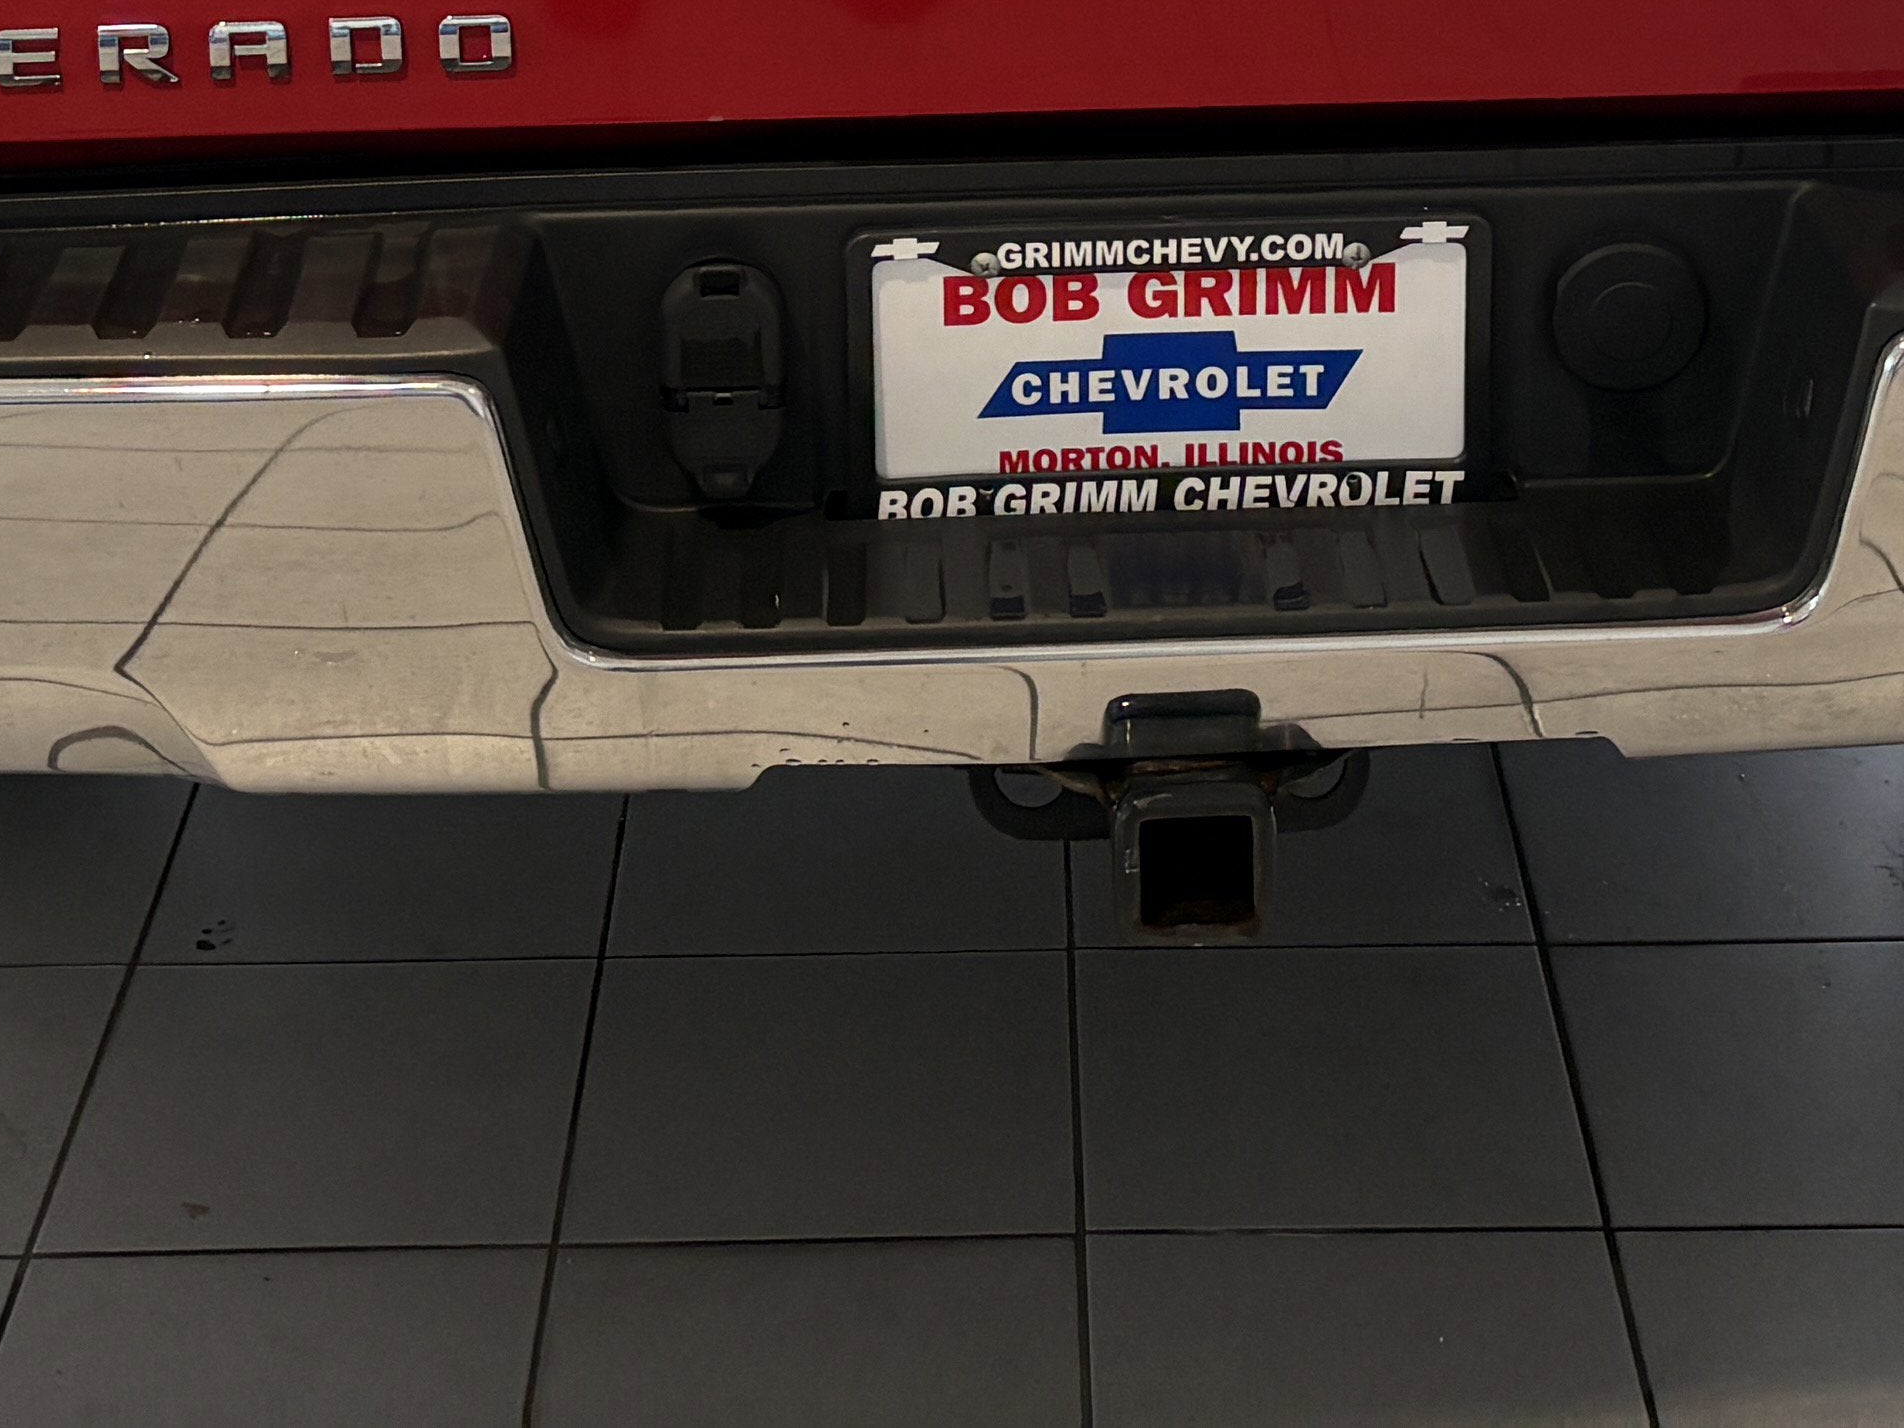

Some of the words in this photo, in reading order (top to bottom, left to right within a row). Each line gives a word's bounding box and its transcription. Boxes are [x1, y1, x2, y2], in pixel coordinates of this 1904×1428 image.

[996, 232, 1345, 270] GRIMMCHEVY.COM
[942, 273, 1101, 327] BOB
[1127, 261, 1396, 319] GRIMM
[1011, 364, 1325, 406] CHEVROLET
[1184, 439, 1344, 468] ILLINOIS
[877, 485, 978, 521] BOB
[993, 478, 1159, 517] GRIMM
[1173, 469, 1466, 512] CHEVROLET
